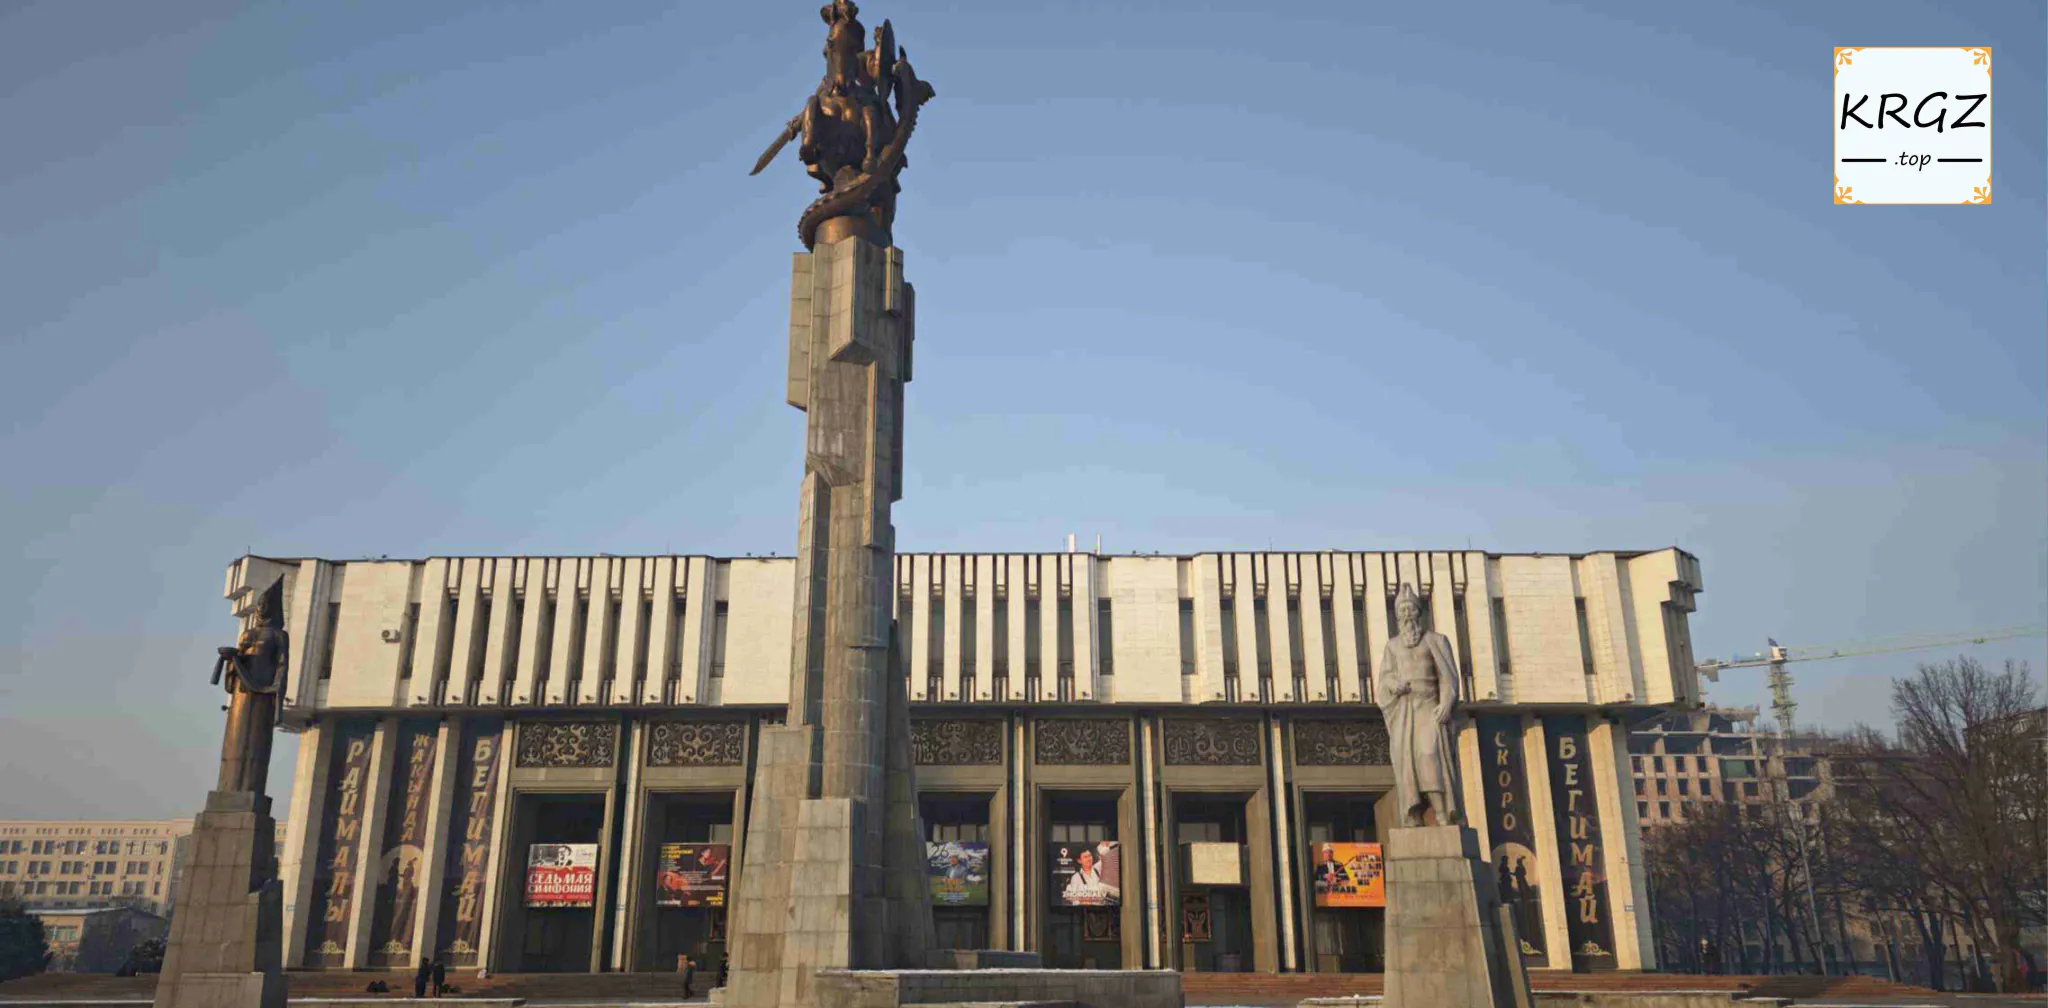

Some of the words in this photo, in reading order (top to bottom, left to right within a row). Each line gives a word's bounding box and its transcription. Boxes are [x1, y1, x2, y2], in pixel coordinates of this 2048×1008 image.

[1494, 731, 1517, 831] СКОРО
[452, 738, 492, 922] БЕГИМАЙ
[1060, 847, 1068, 858] 9
[1558, 736, 1598, 924] БЕГИМАЙ
[528, 883, 592, 894] СИМФОНИЯ
[529, 873, 593, 885] СЕДЬМАЯ
